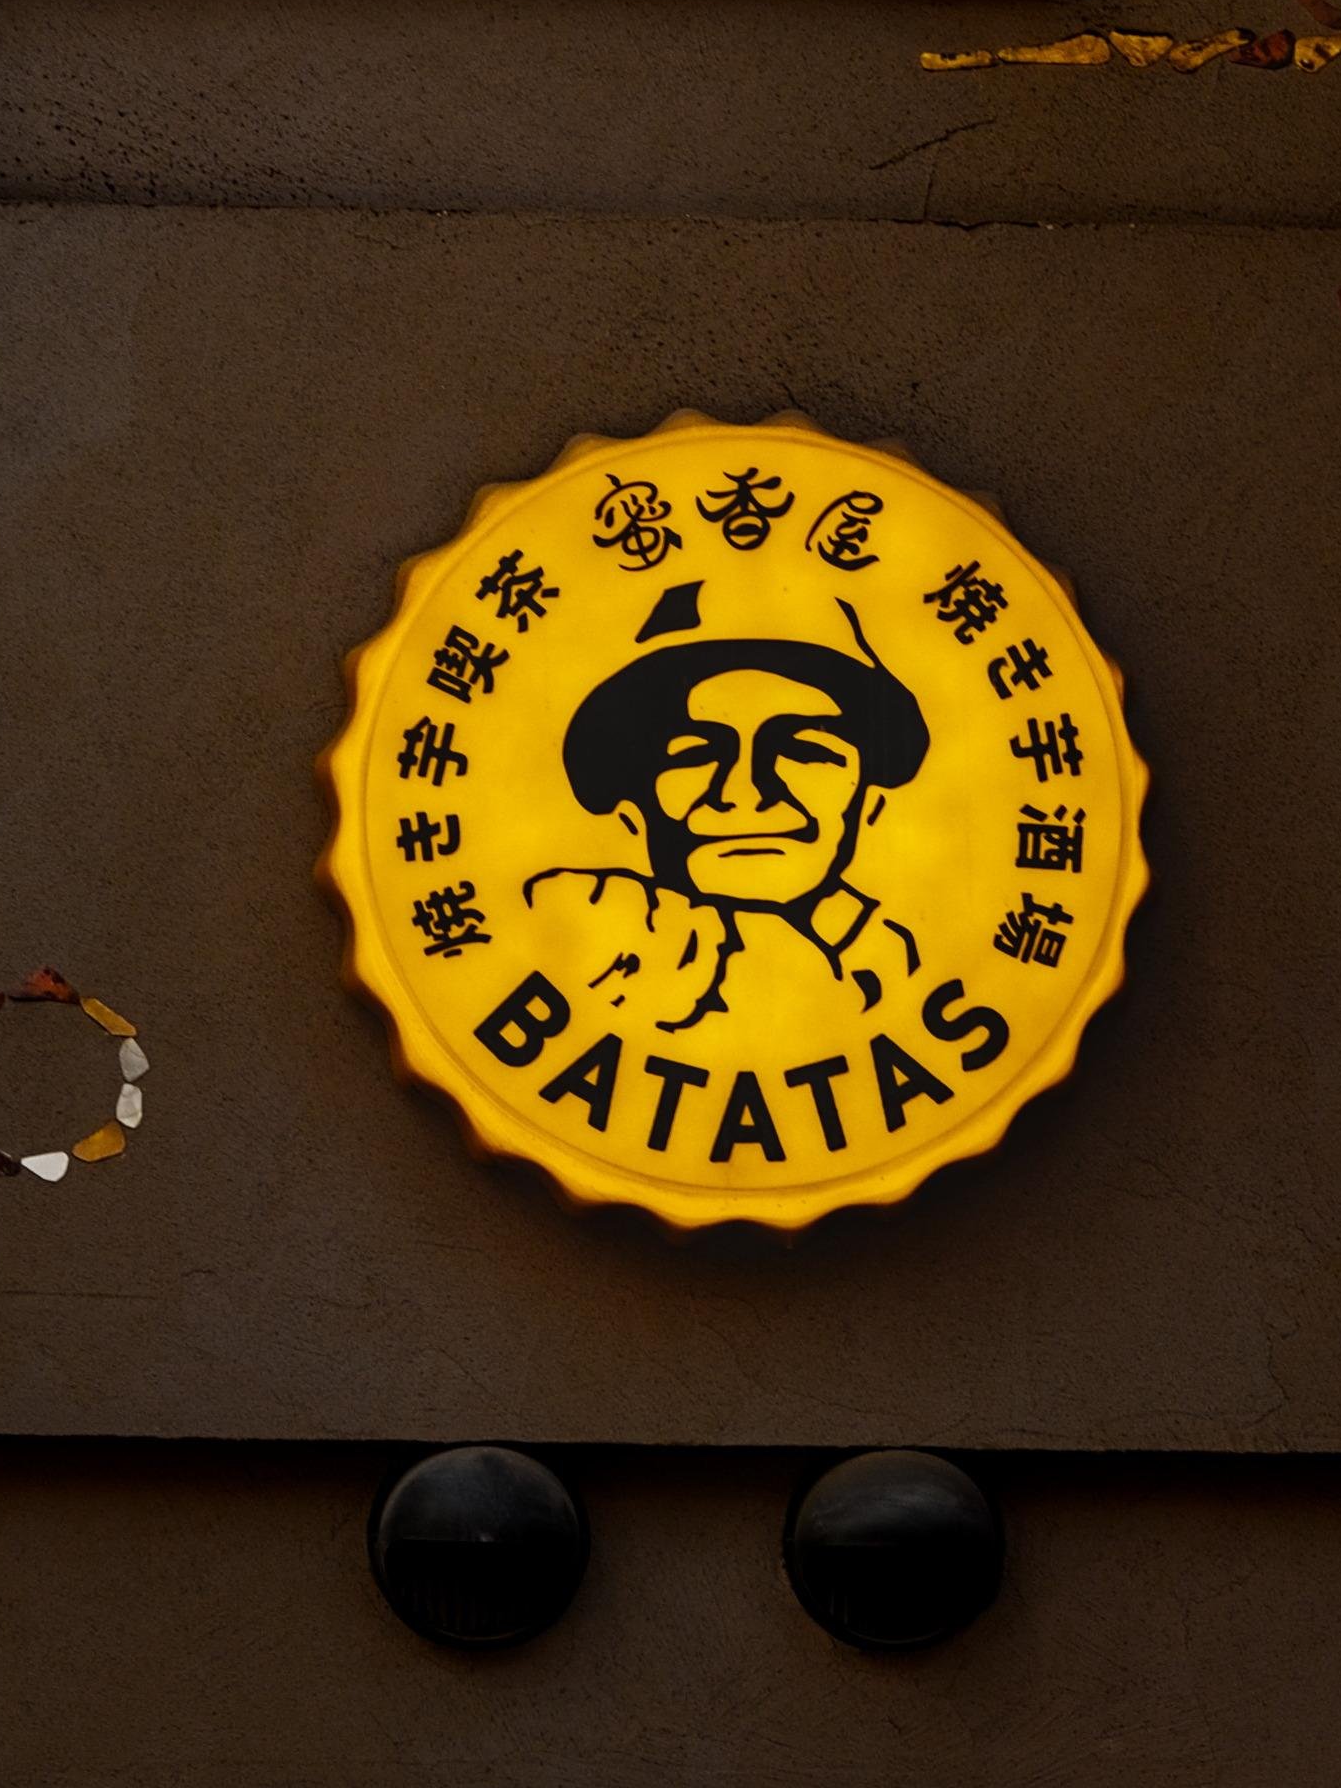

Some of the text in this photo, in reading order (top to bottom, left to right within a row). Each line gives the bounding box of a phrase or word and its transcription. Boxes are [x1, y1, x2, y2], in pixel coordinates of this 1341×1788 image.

[592, 465, 885, 573] 蜜香屋
[396, 548, 561, 960] 焼き芋喫茶
[922, 560, 1088, 968] 焼き芋酒場
[471, 969, 1011, 1164] BATATAS
